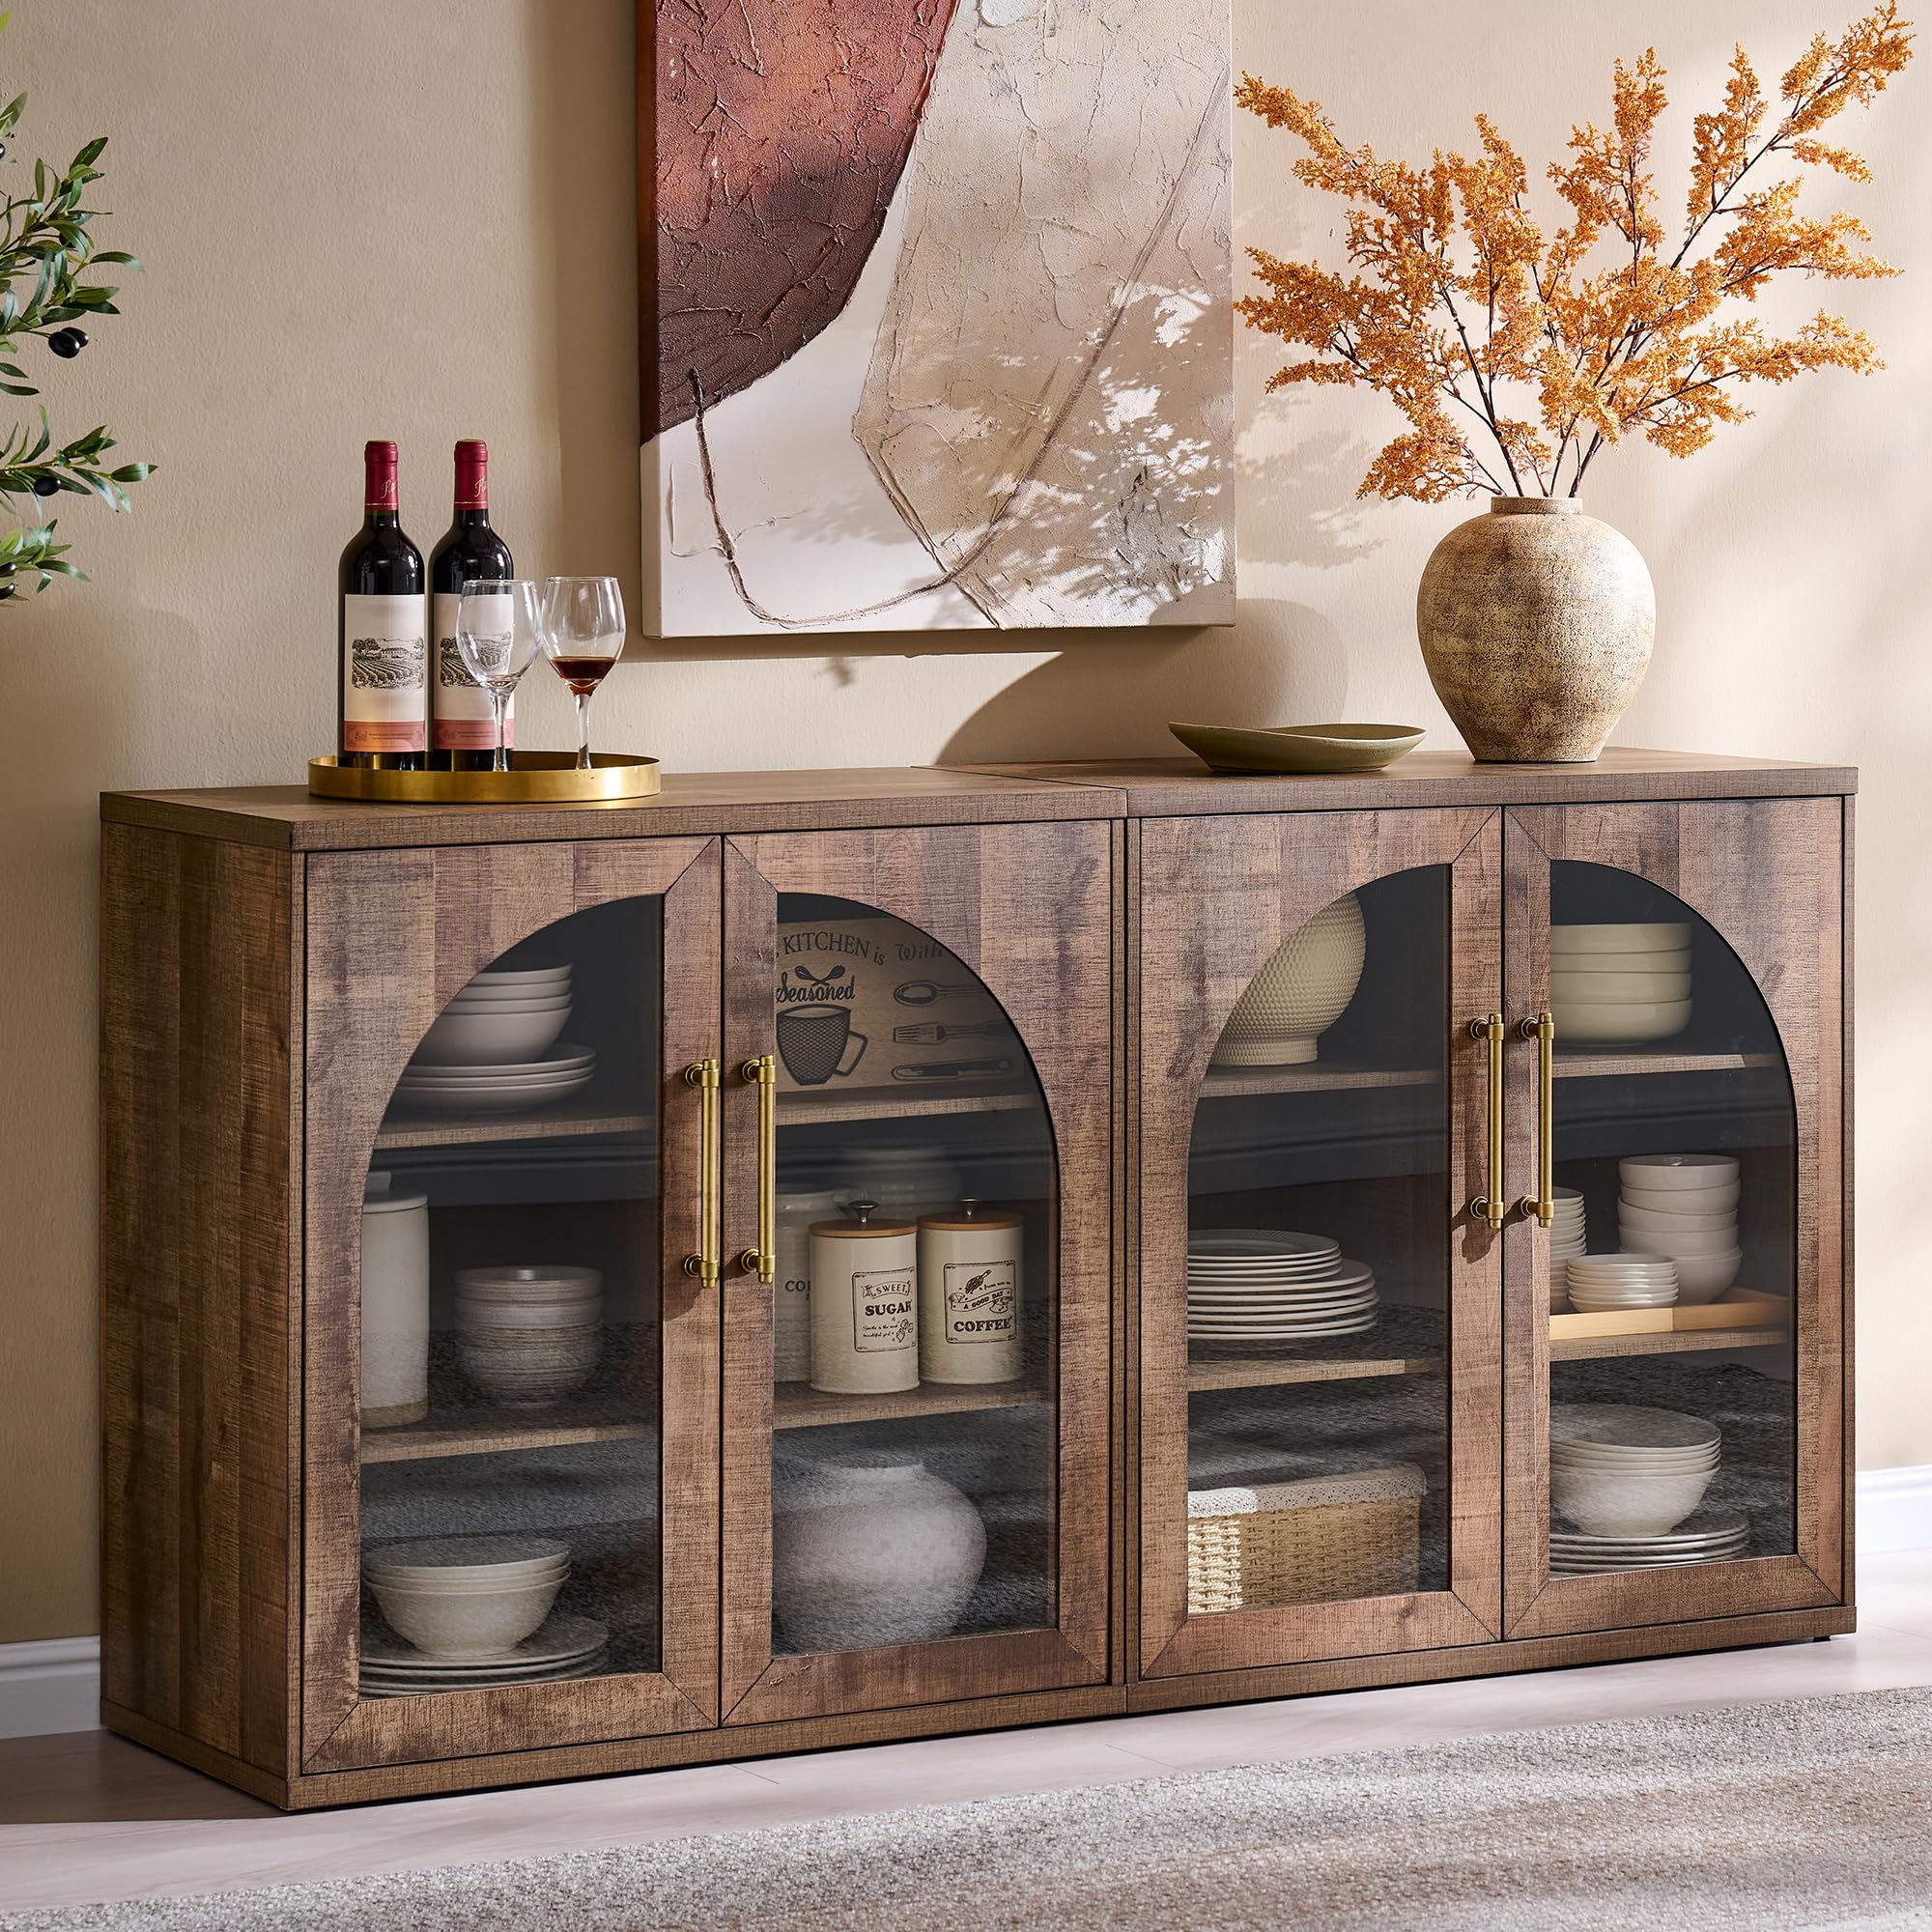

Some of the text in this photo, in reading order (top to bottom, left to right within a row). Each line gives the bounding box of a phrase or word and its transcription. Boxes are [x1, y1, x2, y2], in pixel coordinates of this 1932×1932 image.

[782, 931, 886, 966] KITCHEN is
[777, 971, 856, 1003] Seasoned
[875, 1284, 907, 1294] SWEET
[972, 1295, 990, 1308] GOOD
[991, 1291, 1004, 1300] DAY
[953, 1318, 1011, 1333] COFFEE
